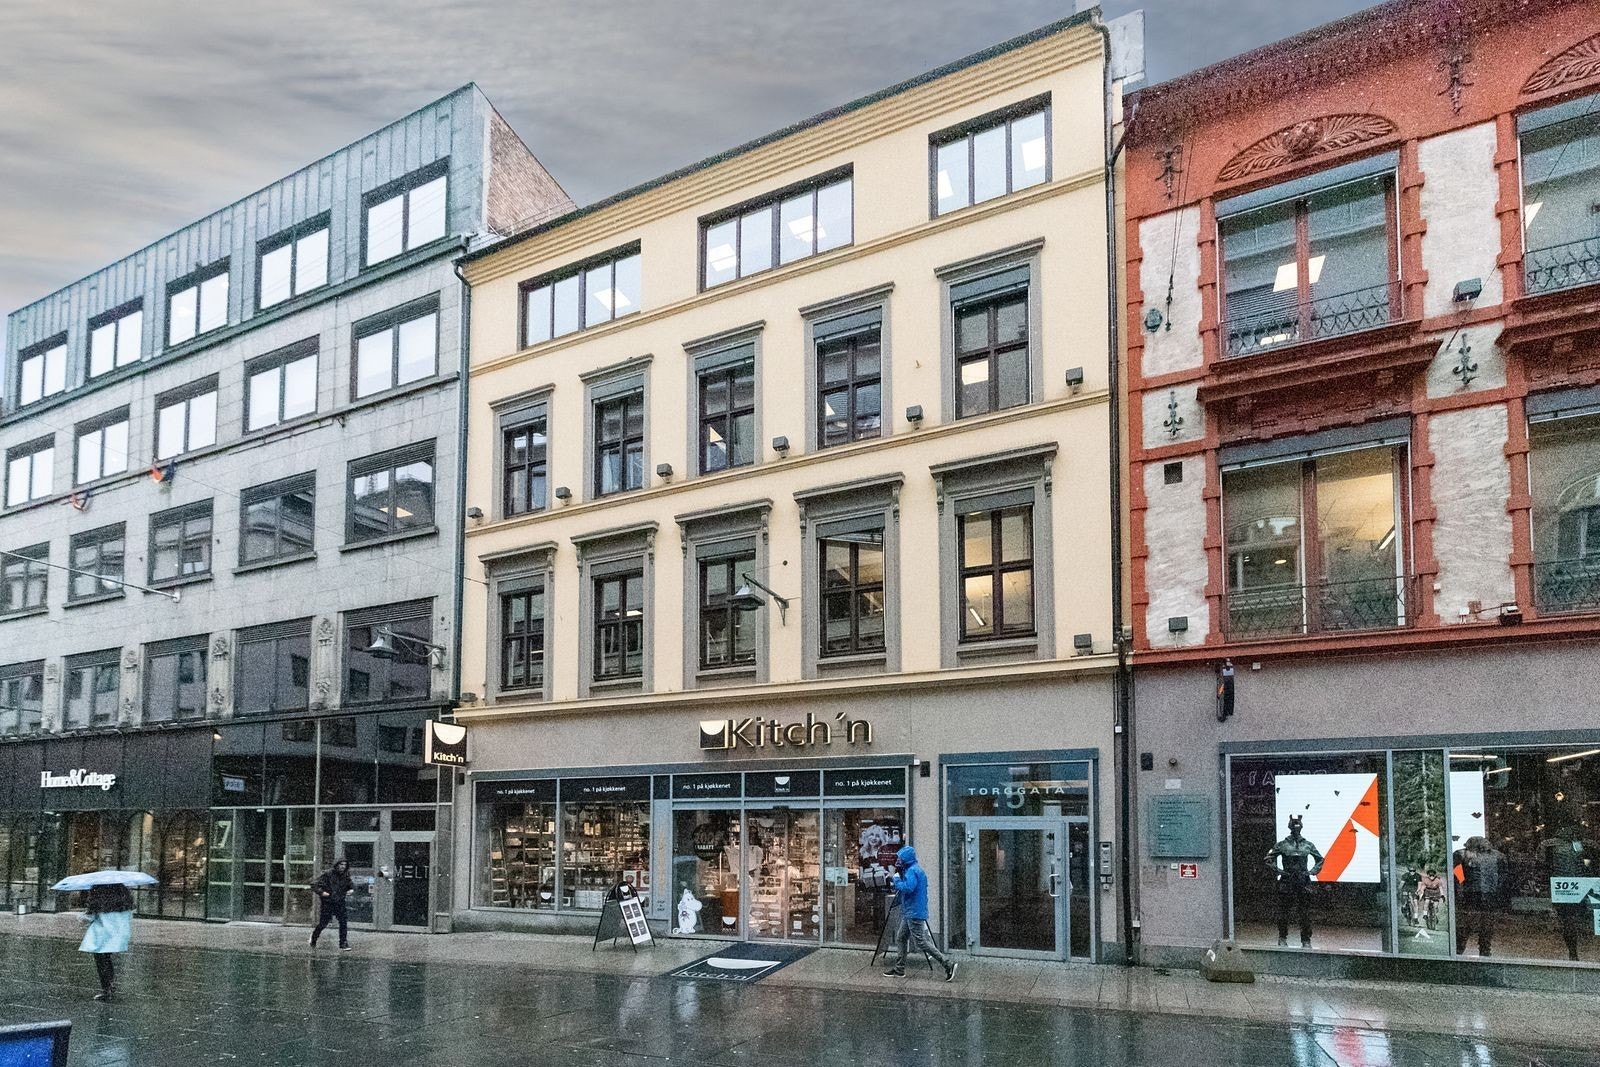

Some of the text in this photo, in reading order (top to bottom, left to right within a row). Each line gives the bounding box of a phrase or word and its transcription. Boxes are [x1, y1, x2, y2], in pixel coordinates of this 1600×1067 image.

[40, 768, 116, 791] Home&Cottage
[968, 786, 1065, 796] TORGGATA
[218, 820, 232, 849] 7
